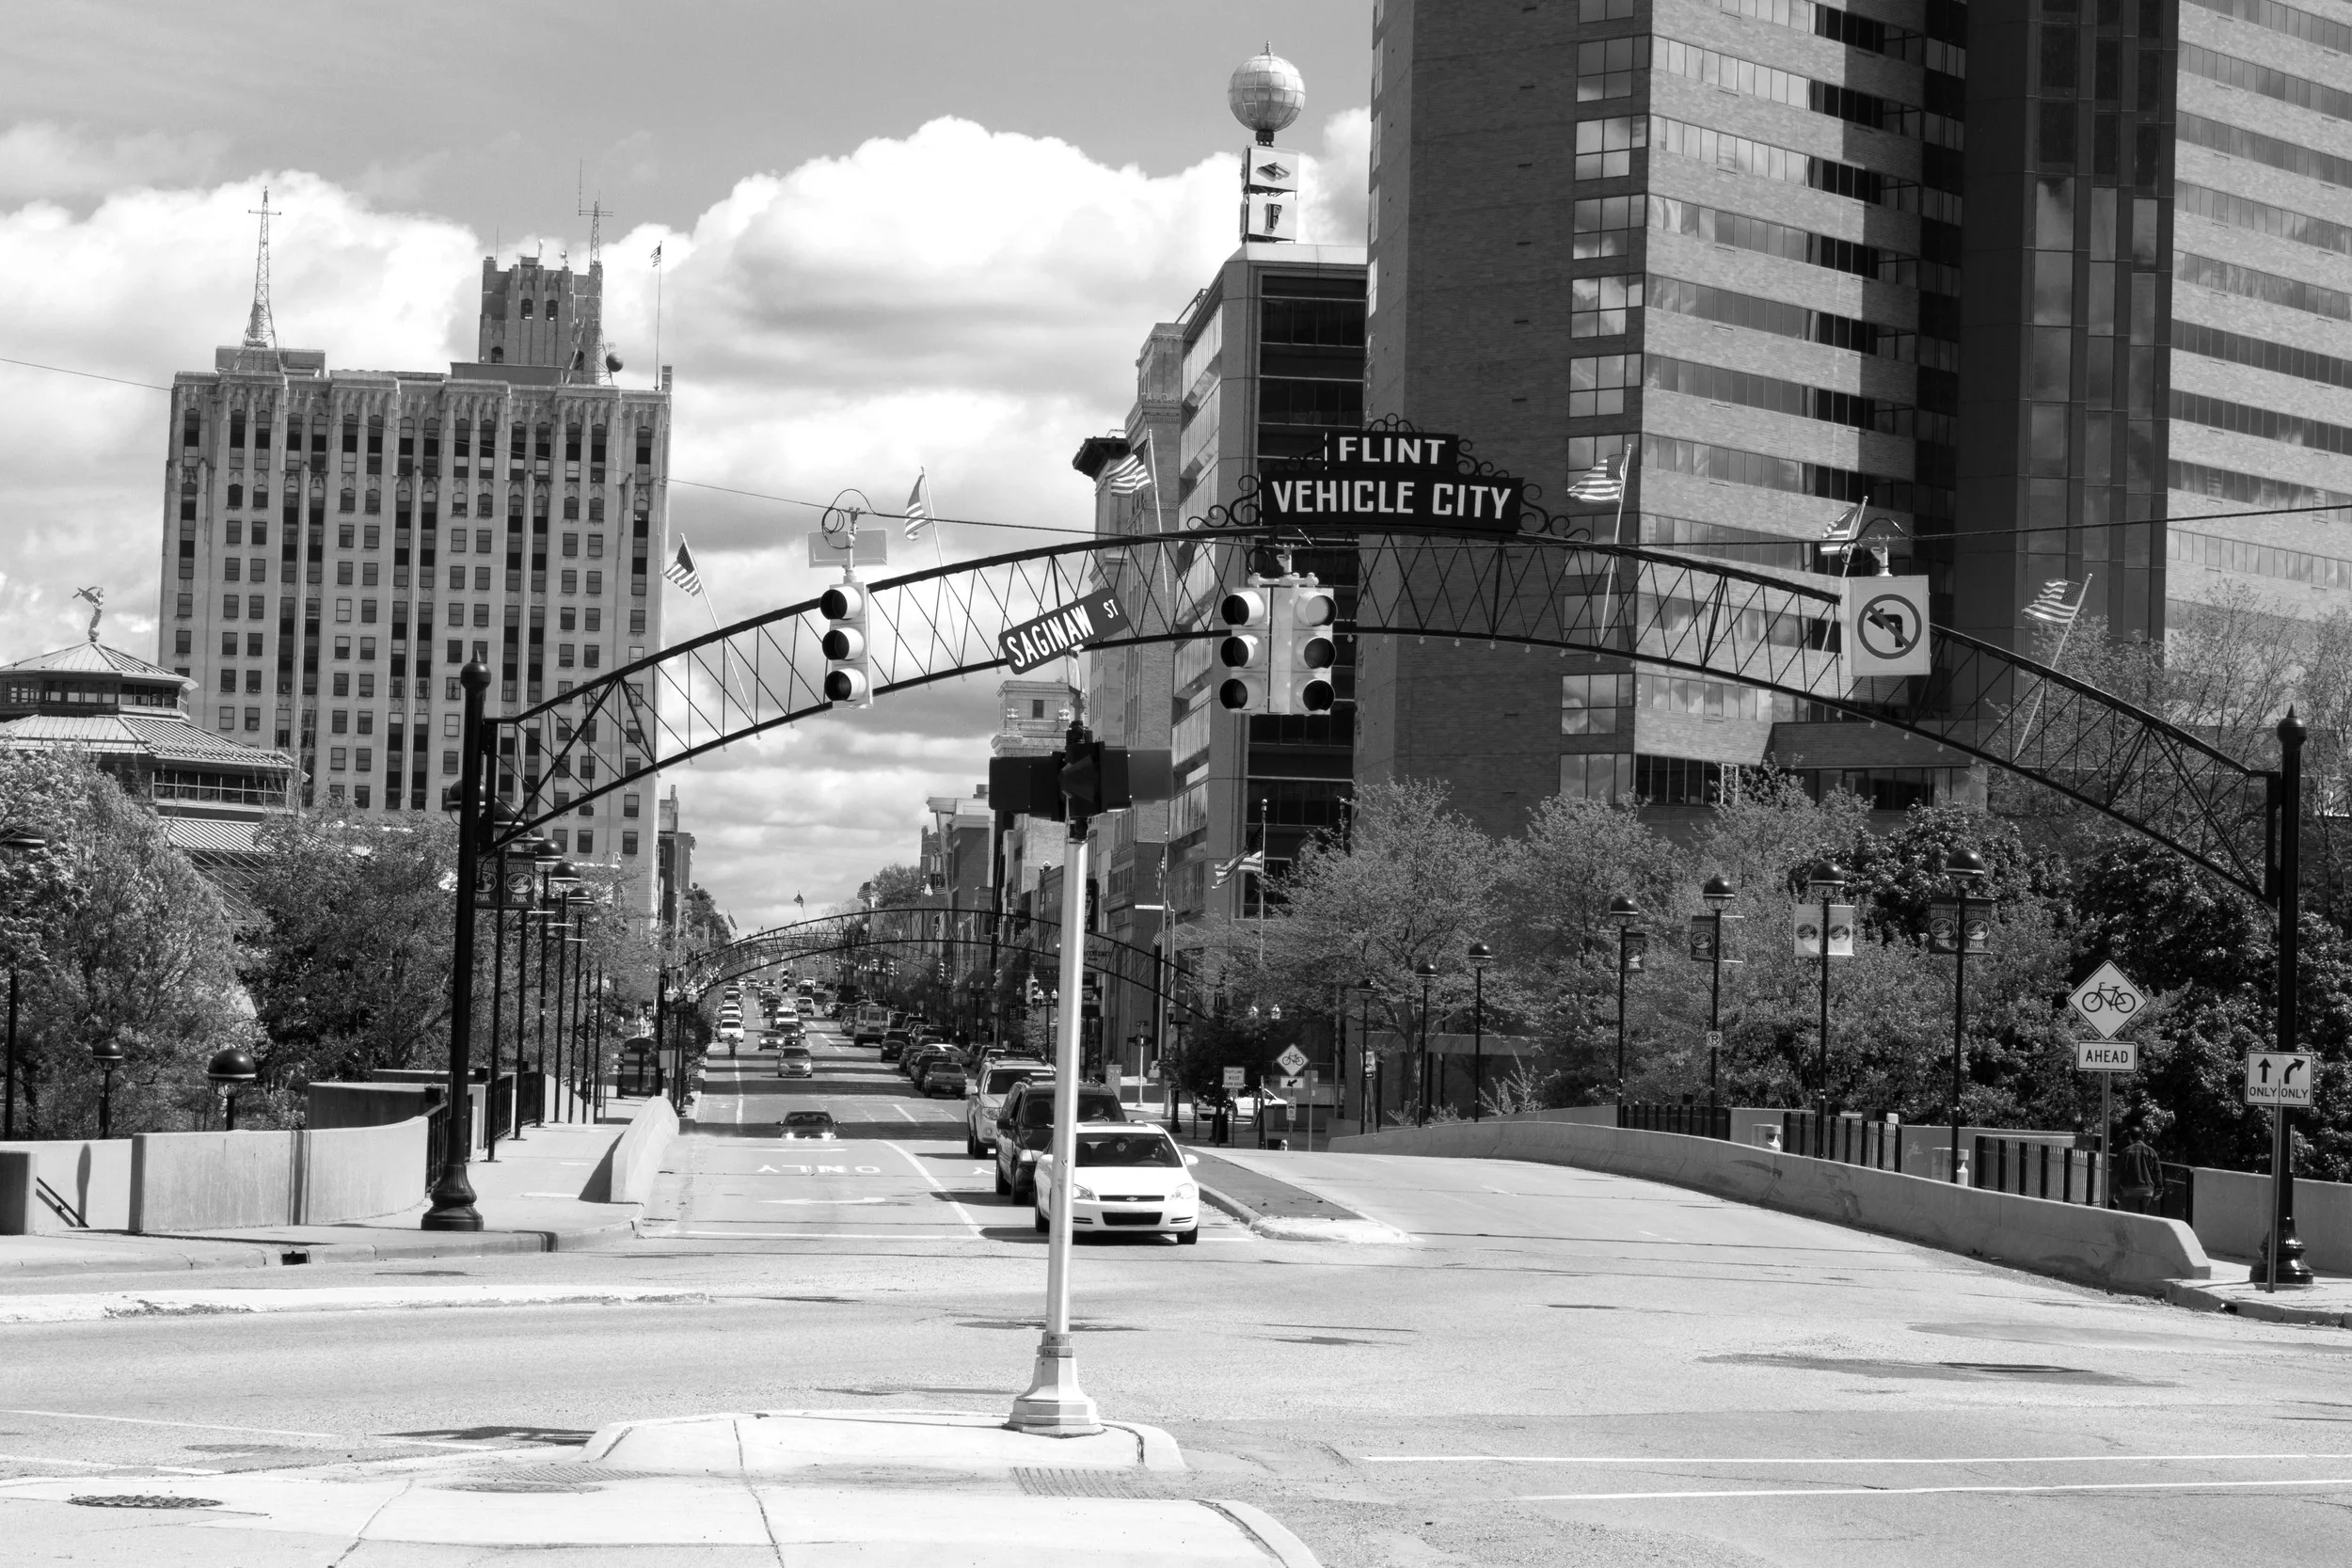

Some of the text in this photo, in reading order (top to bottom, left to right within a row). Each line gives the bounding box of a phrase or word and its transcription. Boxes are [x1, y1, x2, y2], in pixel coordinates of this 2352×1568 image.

[1339, 436, 1445, 465] FLINT
[1272, 481, 1512, 519] VEHICLE CITY
[1007, 598, 1119, 667] SAGINAW ST
[474, 893, 491, 902] PARK
[511, 894, 528, 903] PARK
[1934, 939, 1950, 947] PARK
[1968, 940, 1984, 949] PARK
[2085, 1049, 2129, 1064] AHEAD
[2249, 1086, 2277, 1099] ONLY
[2280, 1087, 2309, 1100] ONLY
[756, 1164, 882, 1173] ONLY
